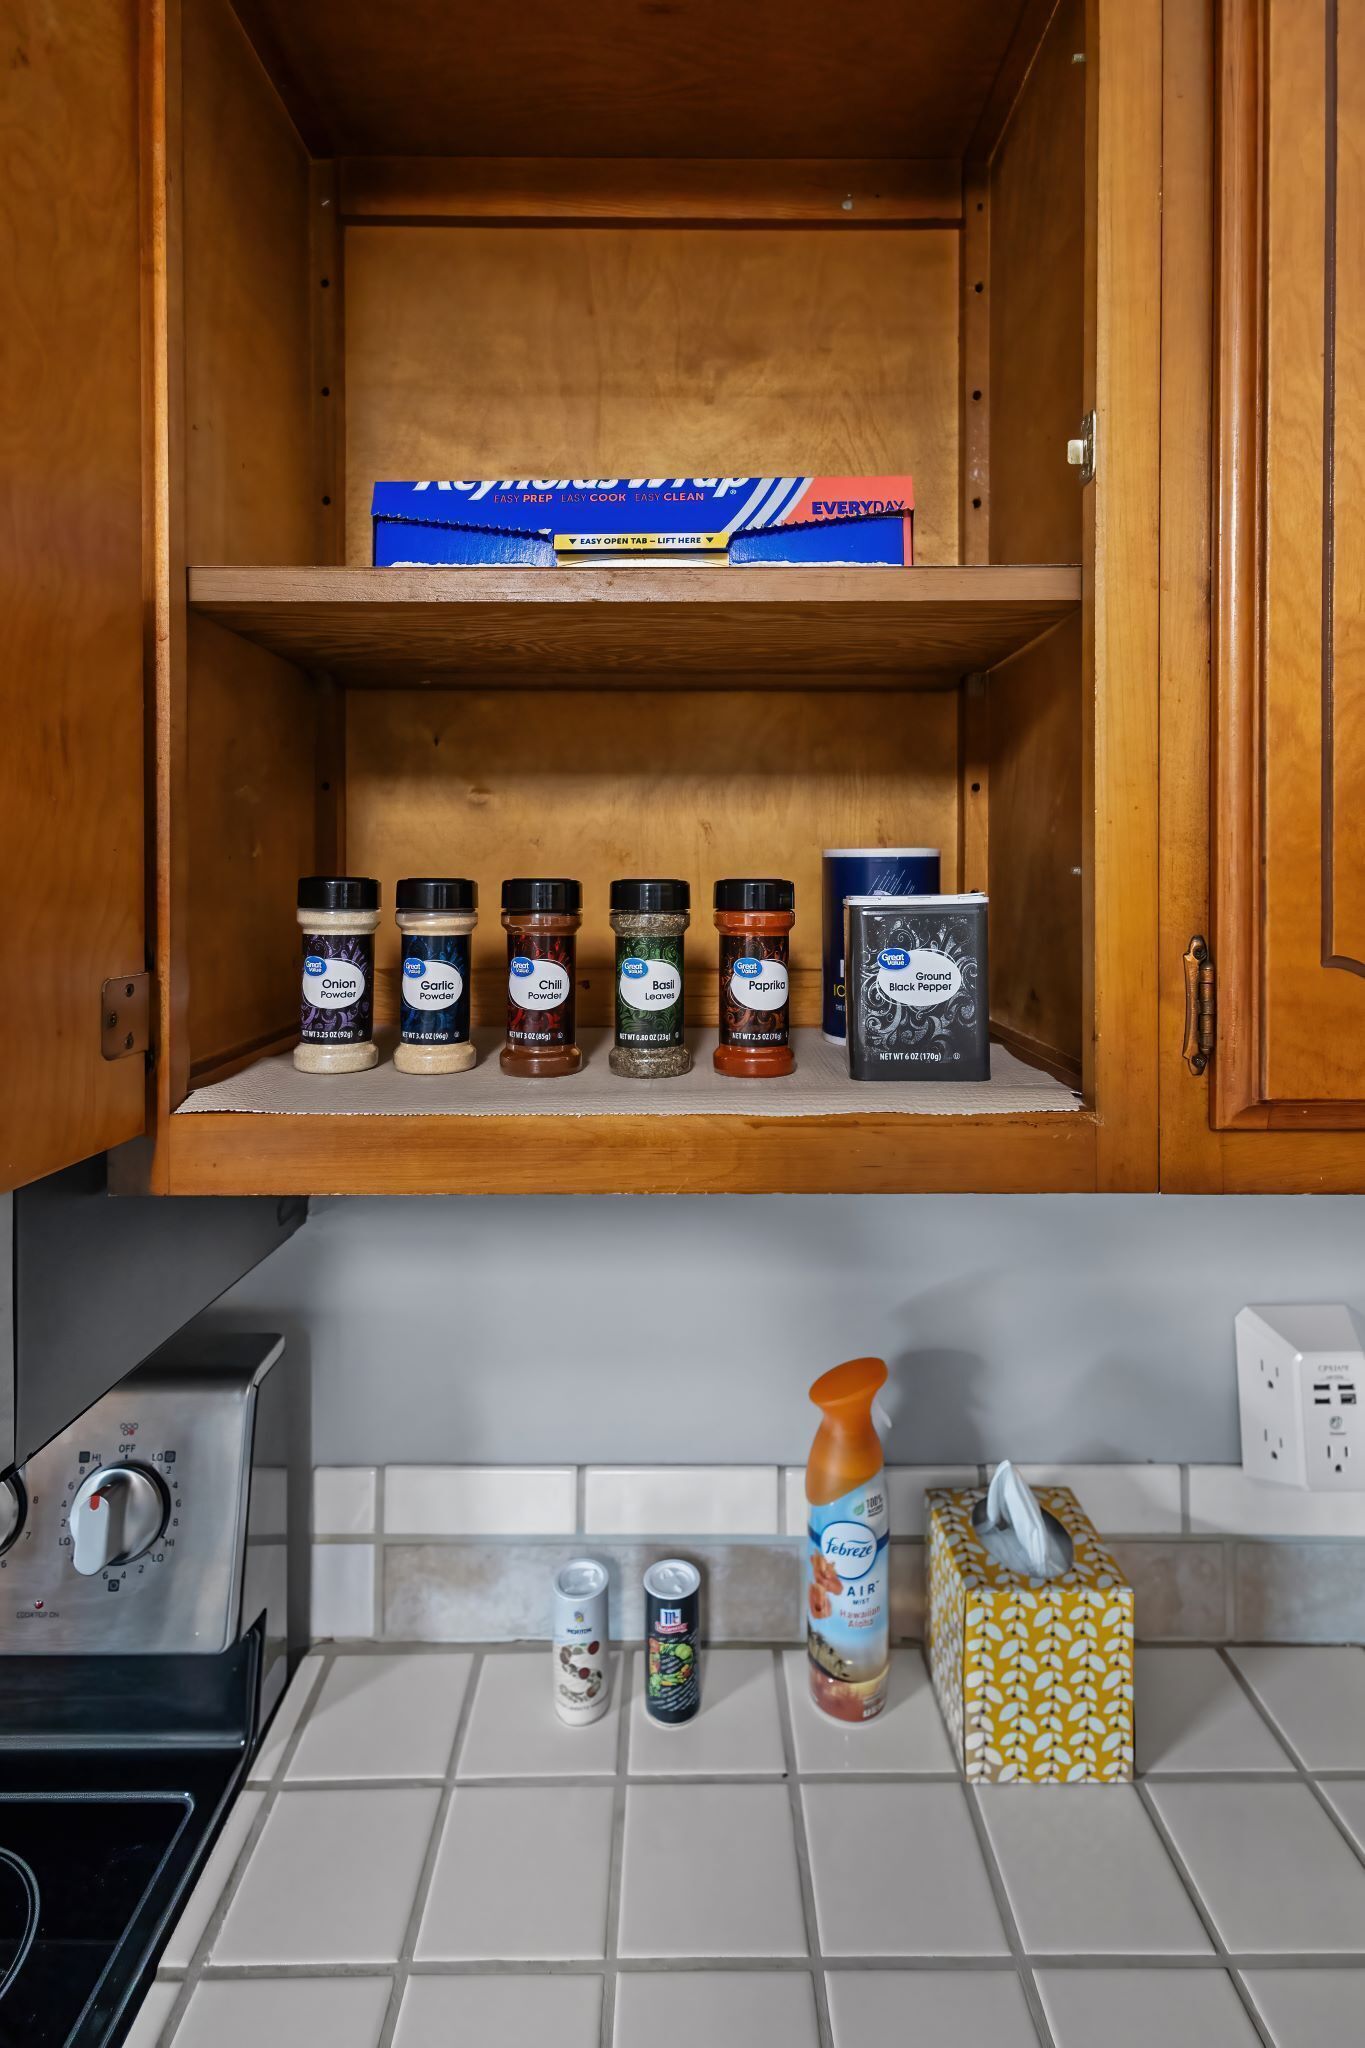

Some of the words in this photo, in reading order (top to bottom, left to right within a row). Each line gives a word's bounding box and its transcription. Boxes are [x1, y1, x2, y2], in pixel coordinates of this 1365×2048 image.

[522, 494, 552, 502] PREP
[590, 493, 626, 502] COOK
[663, 492, 704, 501] CLEAN
[812, 500, 904, 515] EVERYDAY
[881, 953, 905, 962] Great
[737, 962, 758, 970] Great
[915, 971, 951, 981] Ground
[322, 979, 356, 989] Onion
[420, 980, 454, 990] Garlic
[539, 980, 562, 990] Chili
[652, 980, 675, 990] Basil
[749, 980, 786, 992] Paprika
[889, 982, 915, 992] Black
[918, 982, 952, 992] Pepper
[320, 990, 356, 999] Powder
[419, 992, 454, 1000] Powder
[528, 992, 562, 1000] Powder
[645, 992, 675, 1001] Leaves
[536, 1032, 550, 1041] (85g)
[920, 1052, 942, 1061] (170g)
[119, 1444, 136, 1453] OFF
[152, 1453, 163, 1461] LO
[33, 1496, 38, 1504] 8
[61, 1519, 66, 1527] 2
[59, 1537, 70, 1546] LO
[165, 1539, 174, 1547] HI
[826, 1536, 873, 1558] febreze
[847, 1583, 875, 1596] AIR
